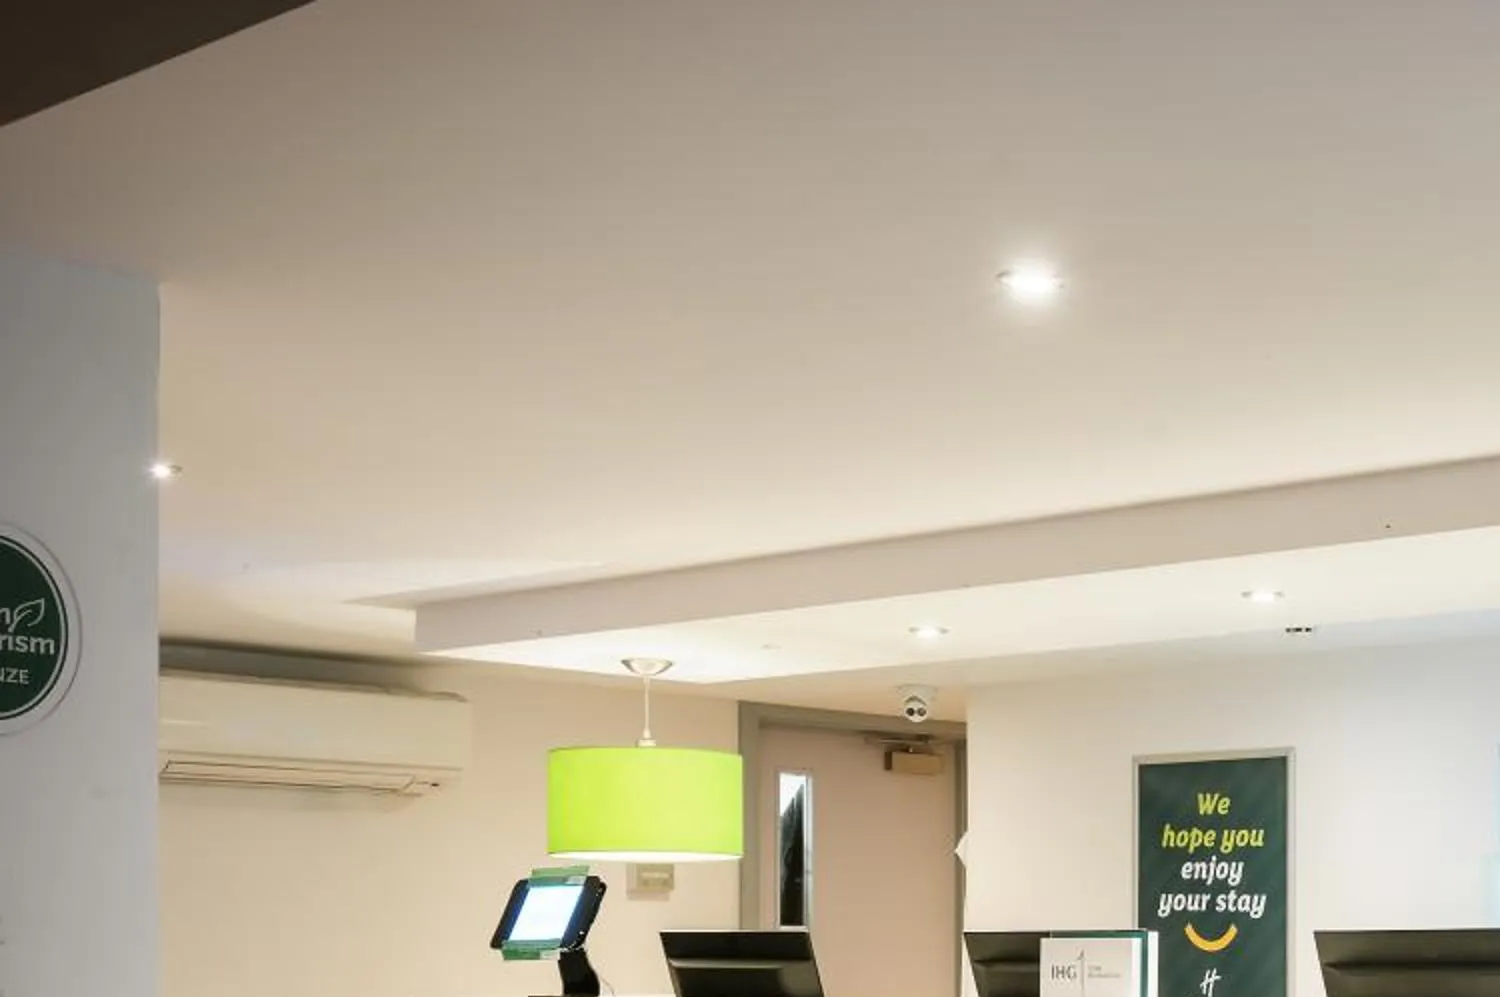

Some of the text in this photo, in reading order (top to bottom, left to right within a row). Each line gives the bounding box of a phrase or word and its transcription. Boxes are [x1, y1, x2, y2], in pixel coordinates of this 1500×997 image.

[1196, 792, 1231, 815] We
[1161, 823, 1265, 853] hope you
[1180, 856, 1244, 886] enjoy
[1157, 890, 1267, 919] your stay
[1051, 964, 1077, 980] IHG
